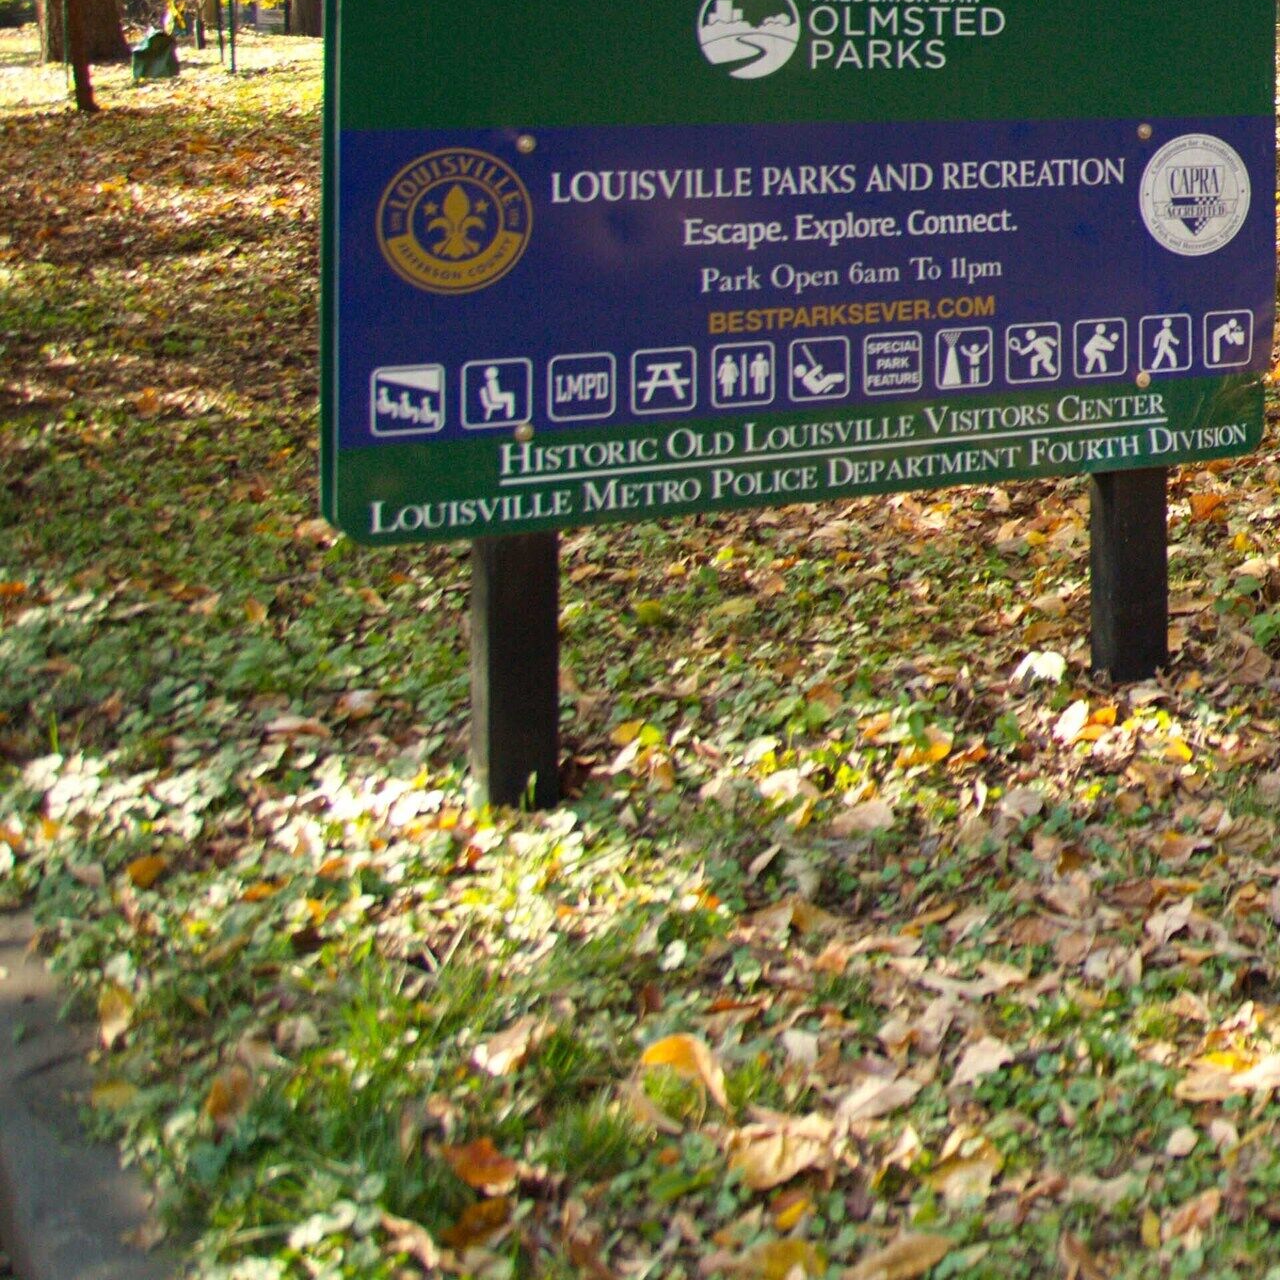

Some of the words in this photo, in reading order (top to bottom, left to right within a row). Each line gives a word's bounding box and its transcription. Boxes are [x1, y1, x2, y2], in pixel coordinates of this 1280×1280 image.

[808, 5, 1006, 37] OLMSTED
[811, 39, 947, 70] PARKS
[388, 155, 522, 210] LOUISVILLE
[551, 169, 752, 203] LOUISVILLE
[761, 164, 856, 196] PARKS
[865, 163, 933, 192] AND
[942, 157, 1126, 190] RECREATION
[1170, 167, 1219, 196] CAPRA
[683, 218, 788, 250] Escape.
[795, 211, 902, 247] Explore.
[907, 209, 1018, 235] Connect.
[701, 266, 762, 293] Park
[771, 263, 840, 294] Open
[849, 261, 900, 284] 6am
[909, 256, 942, 281] To
[951, 257, 1003, 284] 11pm
[708, 294, 996, 335] BESTPARKSEVER.COM
[867, 340, 920, 355] SPECIAL
[876, 356, 911, 370] PARK
[554, 371, 609, 403] LMPD
[867, 371, 920, 386] FEATURE
[501, 437, 659, 475] HISTORIC
[666, 427, 735, 460] OLD
[744, 414, 916, 453] LOUISVILLE
[923, 404, 1049, 435] VISITORS
[1057, 394, 1166, 423] CENTER
[370, 489, 573, 535] LOUISVILLE
[583, 478, 702, 513] METRO
[711, 466, 819, 500] POLICE
[827, 446, 1021, 488] DEPARTMENT
[1029, 434, 1139, 467] FOURTH
[1149, 423, 1248, 455] DIVISION
